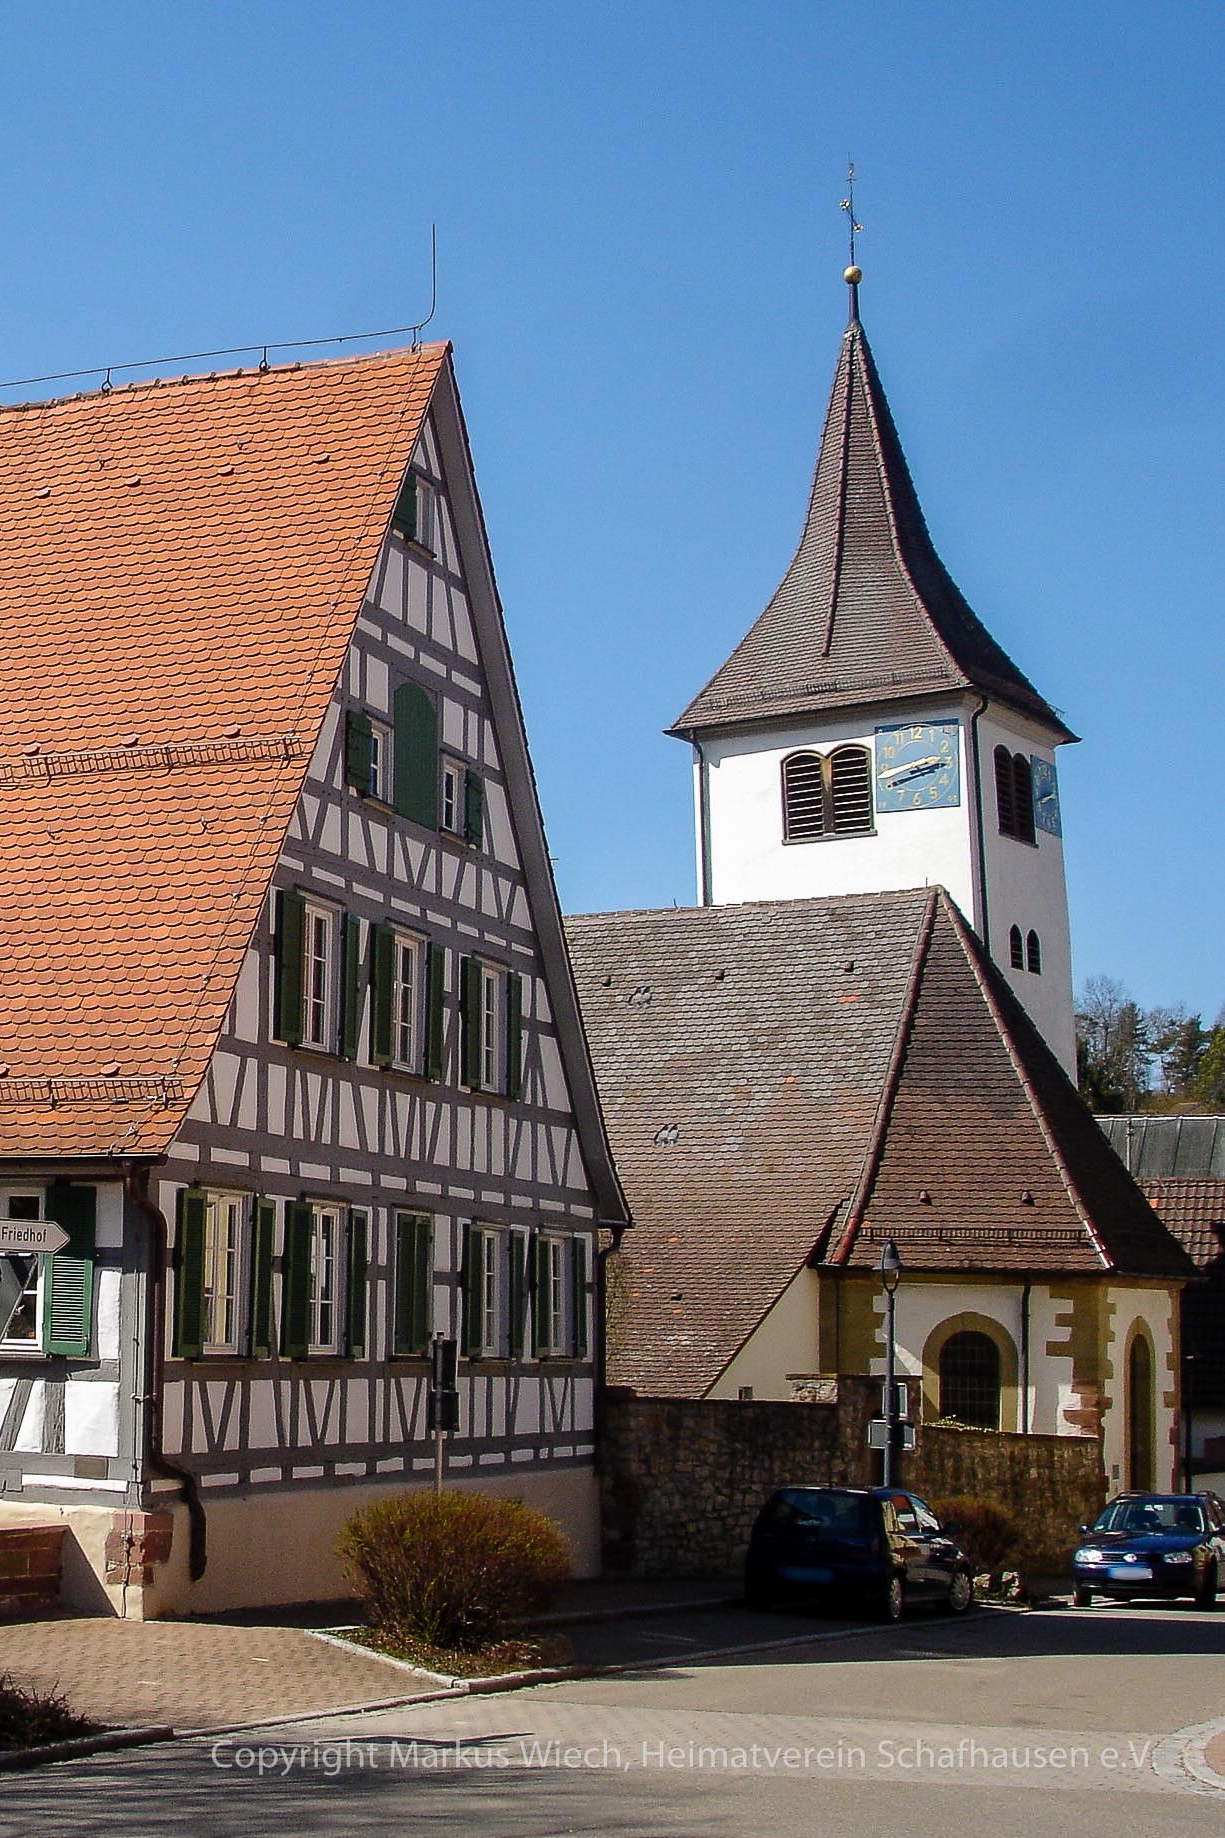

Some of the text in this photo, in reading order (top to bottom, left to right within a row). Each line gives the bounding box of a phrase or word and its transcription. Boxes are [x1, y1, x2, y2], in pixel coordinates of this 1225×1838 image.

[894, 732, 904, 745] 11
[910, 727, 923, 739] 12
[883, 746, 895, 759] 10
[940, 740, 949, 753] 2
[897, 789, 905, 802] 7
[913, 793, 921, 805] 6
[929, 786, 937, 799] 5
[1, 1226, 47, 1242] Friedhof
